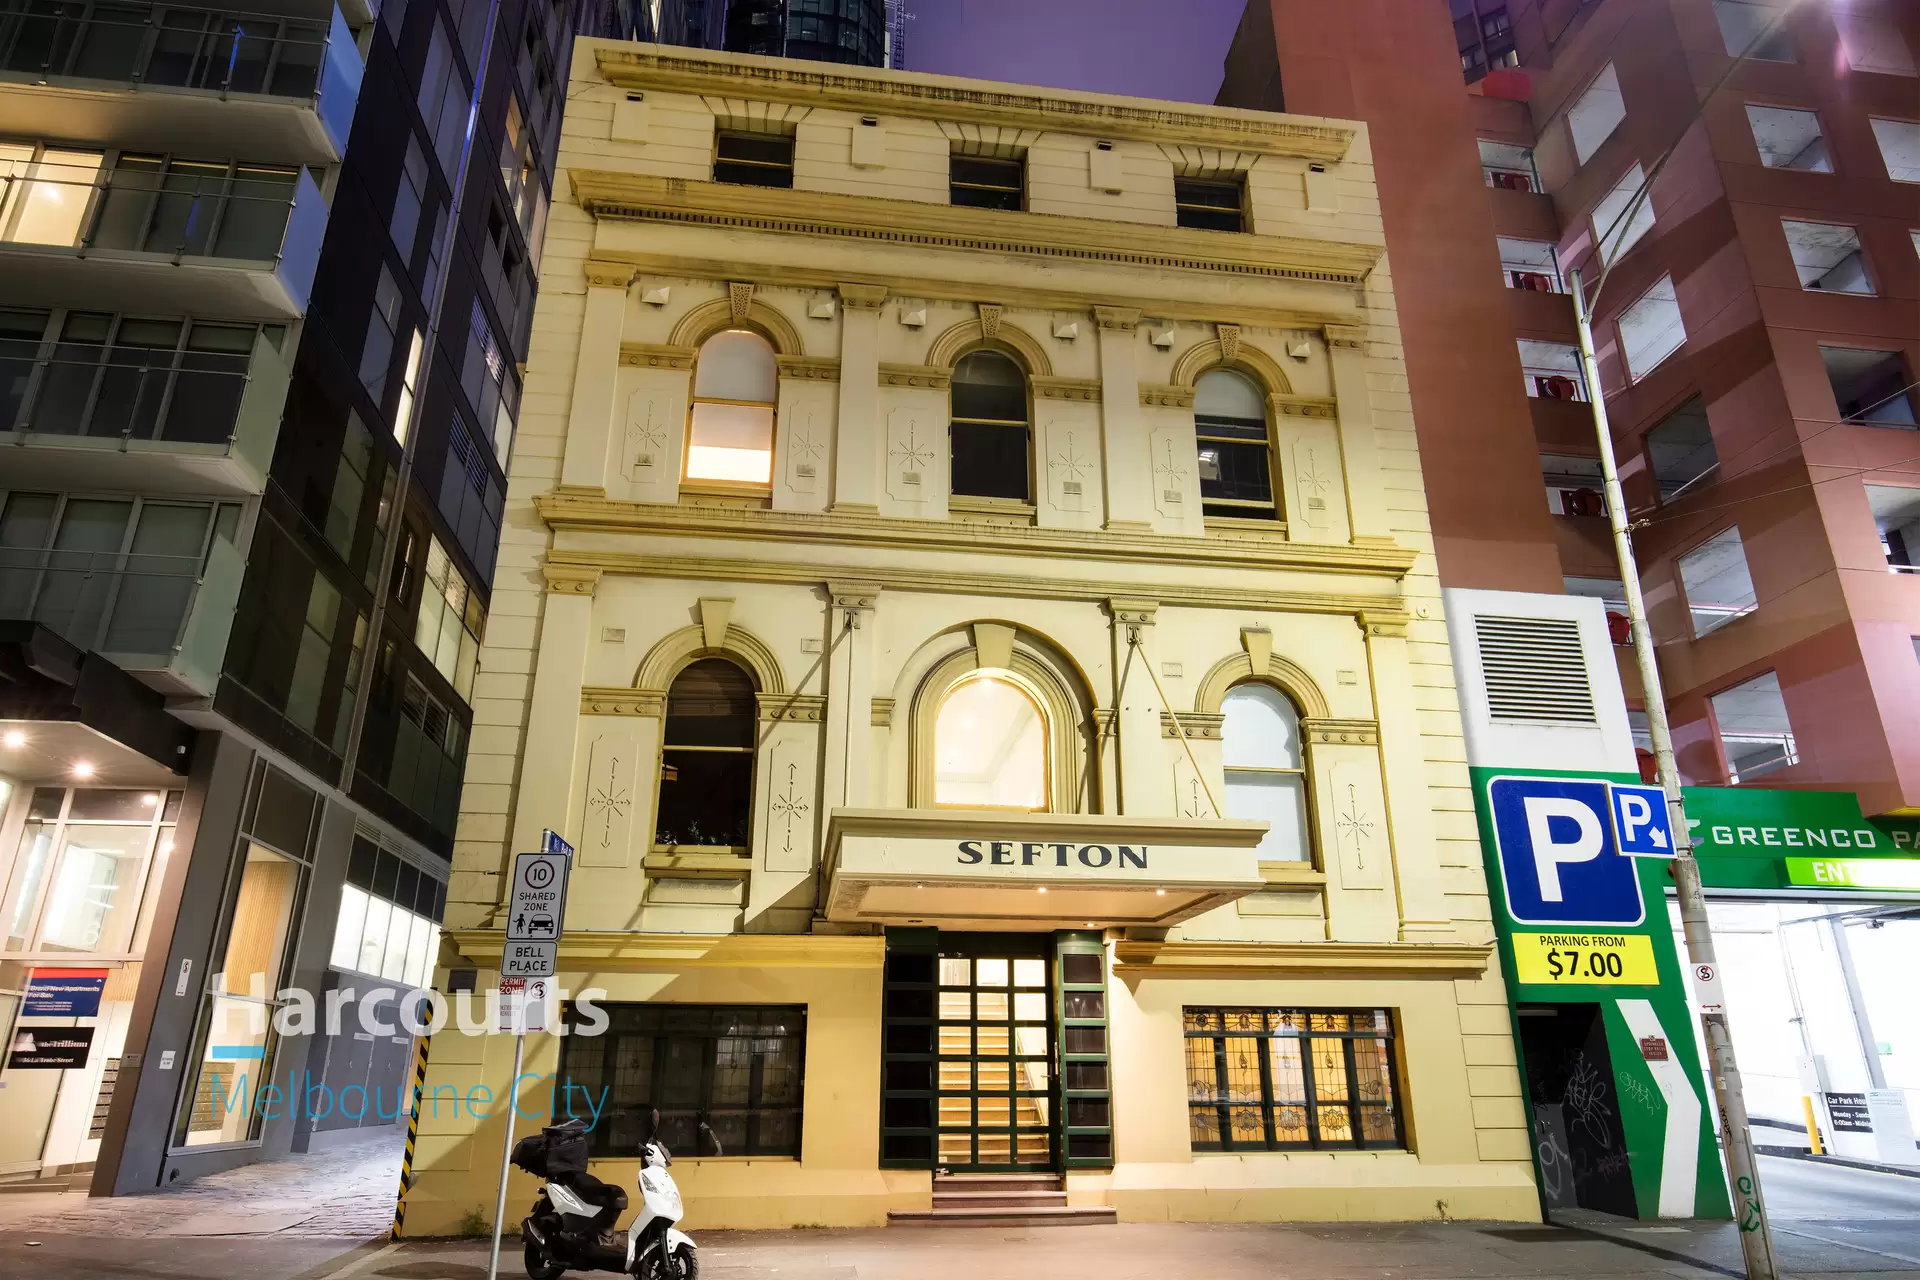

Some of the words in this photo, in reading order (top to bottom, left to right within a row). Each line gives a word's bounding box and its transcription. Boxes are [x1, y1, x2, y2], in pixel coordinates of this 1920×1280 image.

[1619, 794, 1651, 842] P
[1711, 825, 1876, 849] GREENCO
[957, 840, 1148, 869] SEFTON
[1523, 796, 1604, 902] P
[533, 868, 547, 881] 10
[519, 892, 556, 900] SHARED
[524, 902, 548, 911] ZONE
[1539, 935, 1590, 946] PARKING
[1592, 936, 1626, 947] FROM
[515, 947, 545, 958] BELL
[509, 960, 548, 971] PLACE
[1547, 948, 1623, 980] $7.00
[500, 977, 525, 986] PERMIT
[499, 986, 525, 994] ZONE
[1827, 1096, 1839, 1104] Car
[1839, 1097, 1853, 1105] Park
[1853, 1097, 1867, 1105] Hou
